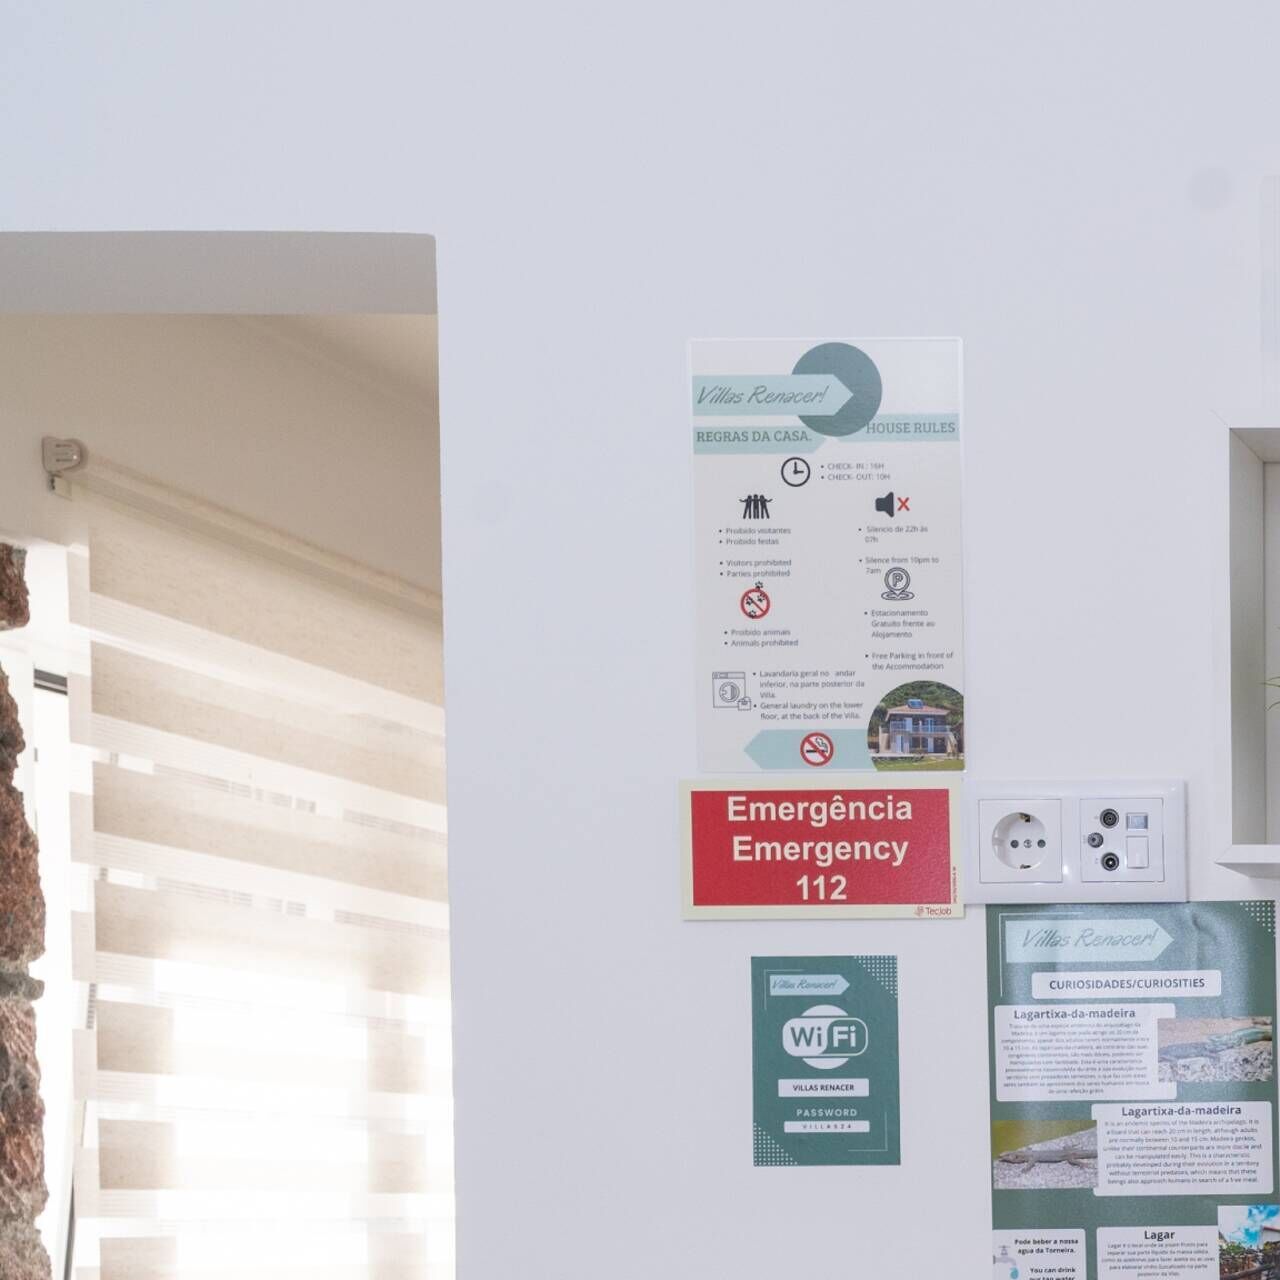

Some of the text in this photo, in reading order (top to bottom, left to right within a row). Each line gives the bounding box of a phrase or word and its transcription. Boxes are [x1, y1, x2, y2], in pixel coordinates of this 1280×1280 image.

[697, 384, 830, 404] Villas Renacer!
[866, 422, 956, 434] HOUSE RULES
[697, 431, 748, 442] REGRAS
[752, 431, 770, 442] DA
[757, 527, 792, 535] visitantes
[726, 559, 792, 568] Visitors prohibited
[865, 556, 940, 566] Silence from 10pm to
[726, 569, 791, 578] Parties prohibited
[871, 609, 929, 617] Estacionamento
[902, 619, 924, 627] frente
[763, 628, 791, 636] animais
[871, 631, 913, 640] Alojamento
[731, 639, 799, 648] Animals prohibited
[871, 651, 954, 662] Free Parking in front of
[871, 662, 945, 671] the Accommodation
[759, 670, 799, 678] Lavandaria
[800, 670, 819, 679] geral
[800, 681, 820, 690] parte
[821, 680, 853, 690] posterior
[760, 701, 788, 710] General
[789, 701, 817, 711] laundry
[829, 701, 842, 709] the
[843, 701, 864, 709] lower
[781, 712, 788, 720] at
[789, 712, 802, 720] the
[803, 712, 820, 720] back
[821, 712, 830, 720] of
[830, 712, 843, 720] the
[727, 795, 912, 827] Emergência
[732, 835, 909, 867] Emergency
[796, 875, 848, 901] 112
[1022, 928, 1071, 948] Villas
[1049, 977, 1206, 991] CURIOSIDADES/CURIOSITIES
[1013, 1007, 1136, 1021] Lagartixa-da-madeira
[796, 1108, 858, 1117] PASSWORD
[1121, 1104, 1242, 1118] Lagartixa-da-madeira
[1144, 1229, 1176, 1242] Lagar
